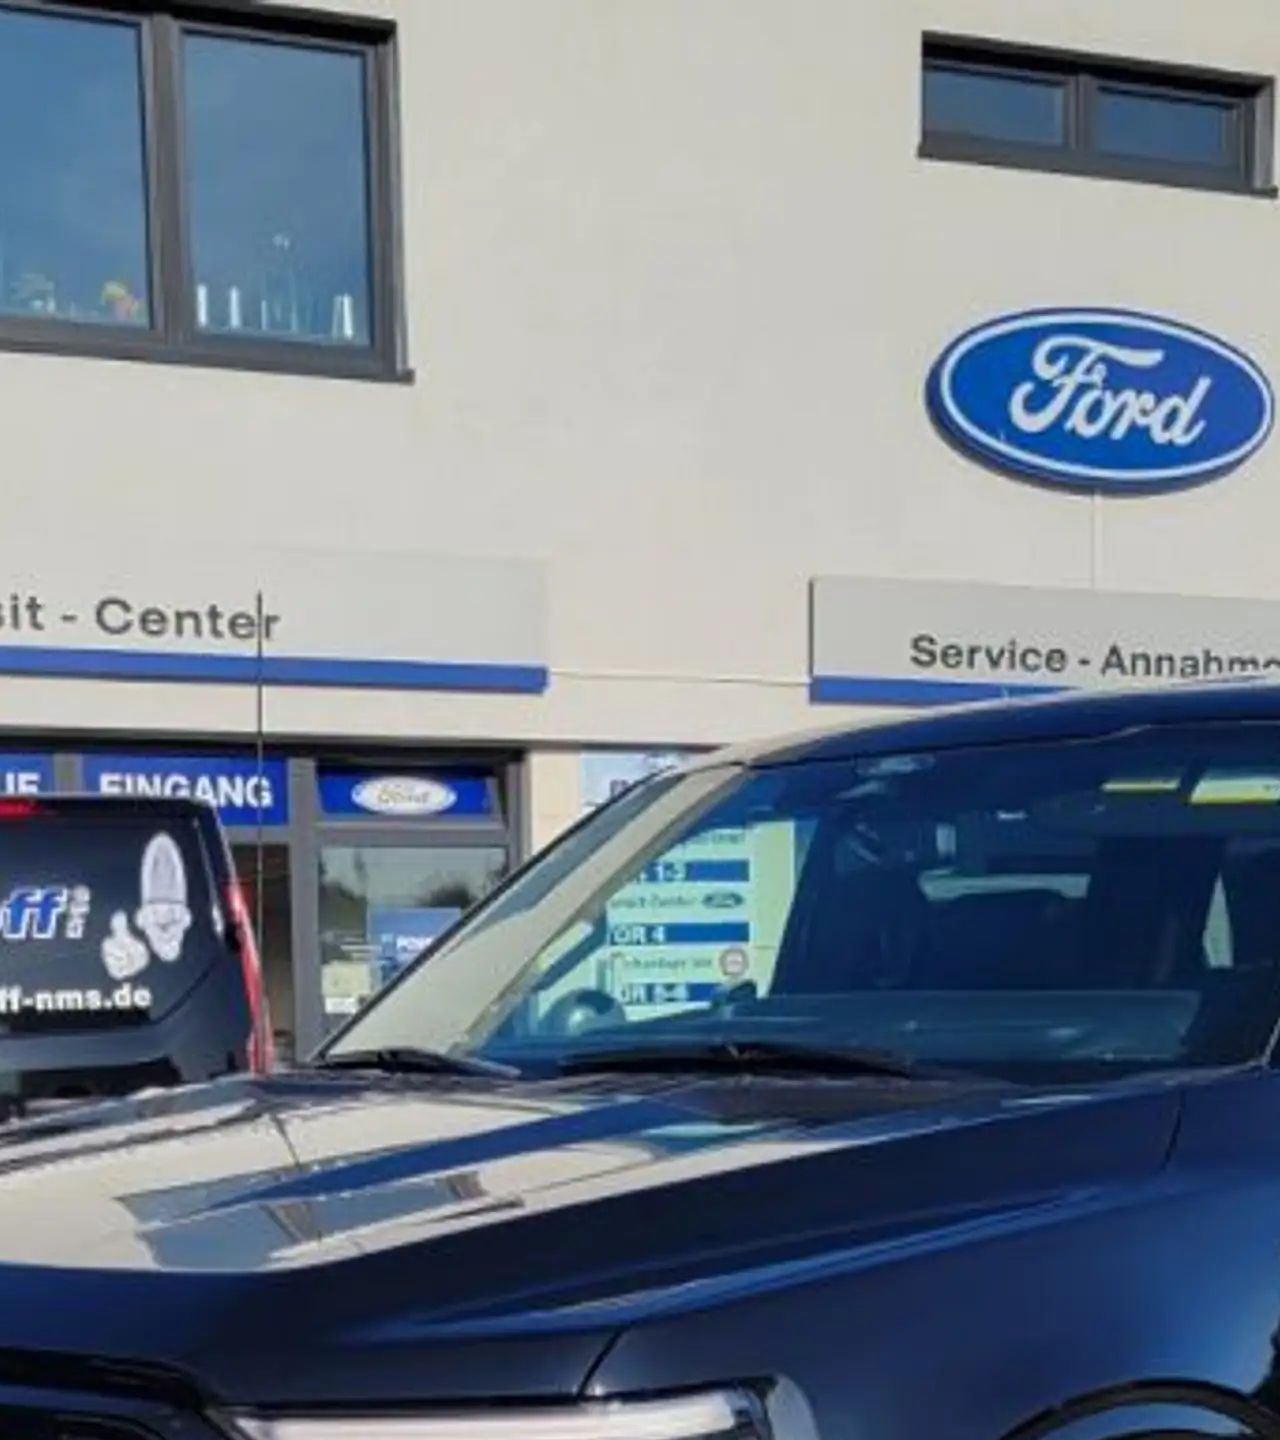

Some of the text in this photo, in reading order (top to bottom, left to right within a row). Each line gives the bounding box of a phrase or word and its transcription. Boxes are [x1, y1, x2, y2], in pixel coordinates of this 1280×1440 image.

[1008, 334, 1212, 446] Ford
[95, 596, 281, 640] Center
[909, 633, 1068, 674] Service
[99, 771, 274, 809] EINGANG
